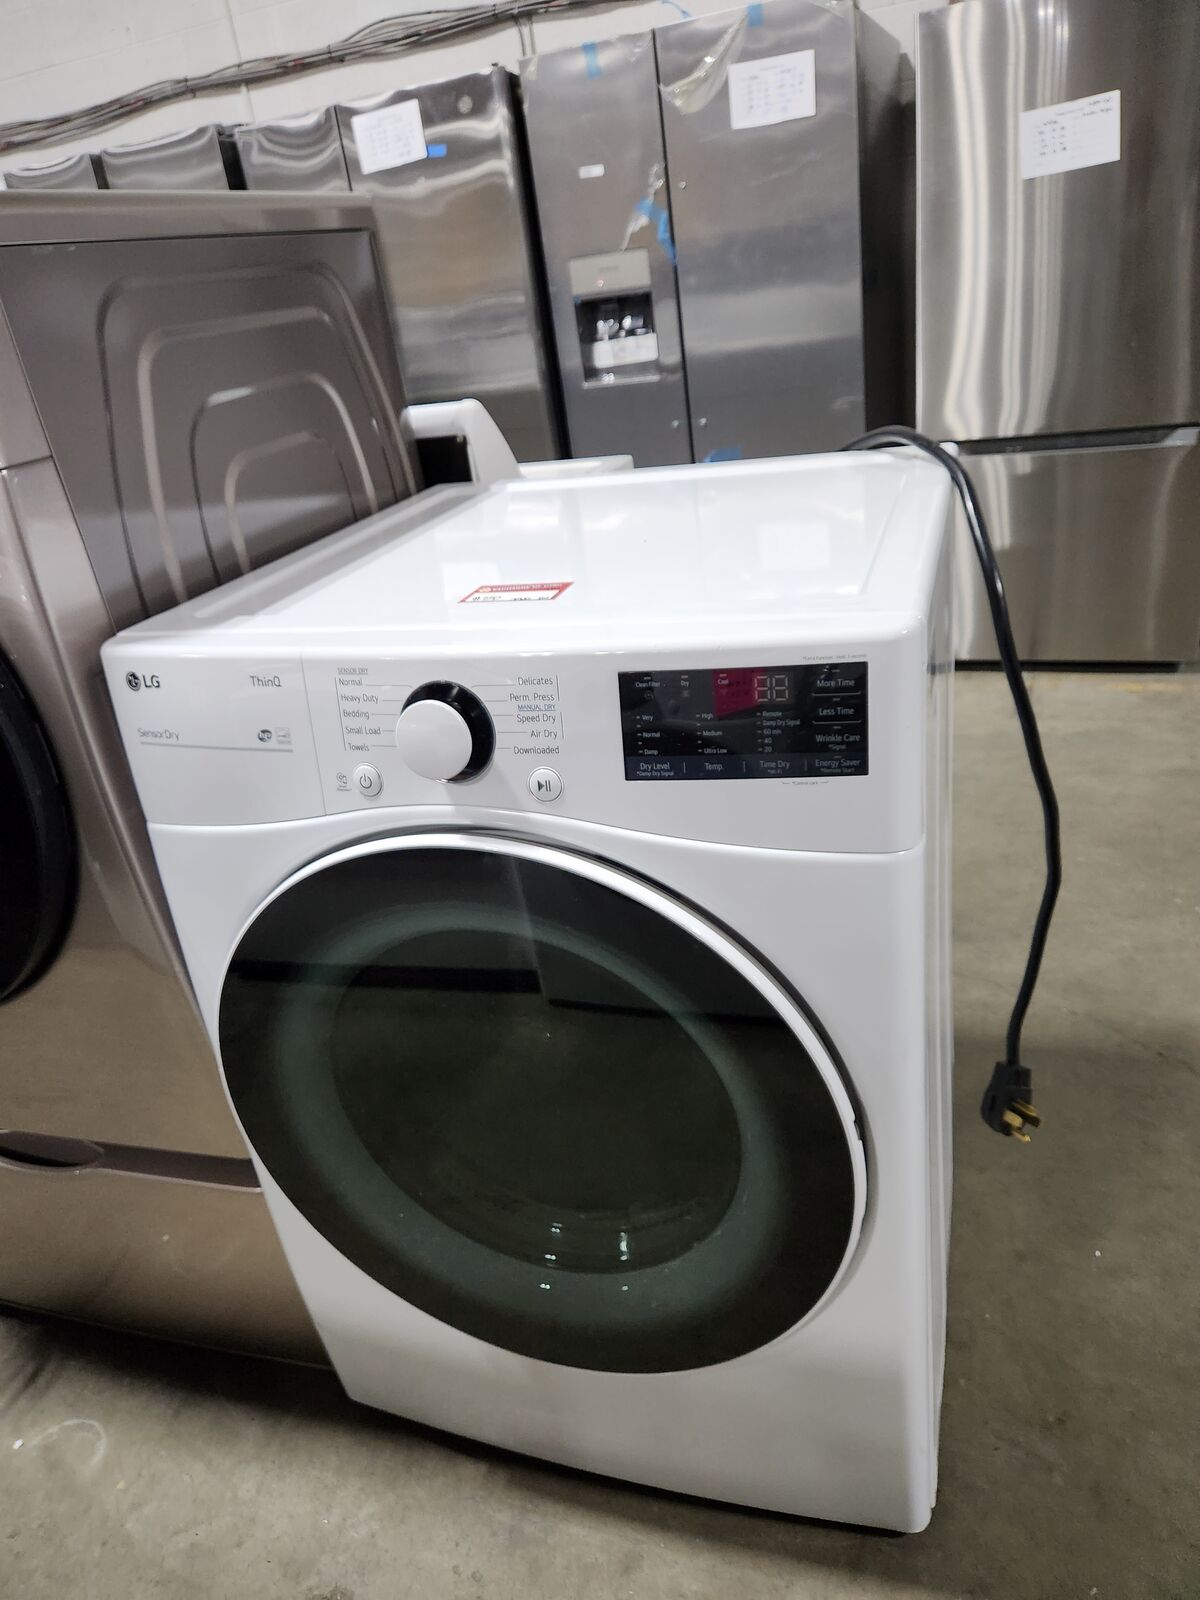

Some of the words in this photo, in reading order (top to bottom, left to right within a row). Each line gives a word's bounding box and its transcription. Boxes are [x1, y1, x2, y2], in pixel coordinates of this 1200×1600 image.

[142, 674, 160, 688] LG
[249, 675, 283, 688] ThinQ
[338, 678, 362, 686] Normal
[518, 676, 554, 686] Delicates
[816, 680, 836, 688] More
[837, 678, 855, 686] Time
[340, 694, 361, 703] Heavy
[362, 694, 379, 703] Duty
[510, 693, 530, 702] Perm.
[533, 692, 555, 702] Press
[344, 710, 370, 720] Bedding
[819, 708, 835, 716] Less
[836, 707, 854, 715] Time
[516, 714, 540, 724] Speed
[542, 714, 556, 724] Dry
[346, 726, 363, 734] Small
[365, 727, 381, 735] Load
[530, 730, 542, 738] Air
[544, 730, 558, 740] Dry
[816, 734, 842, 742] Wrinkle
[844, 734, 860, 742] Care
[348, 743, 370, 752] Towels
[514, 746, 560, 755] Downloaded
[640, 762, 652, 770] Dry
[653, 762, 670, 770] Level
[706, 762, 724, 771] Temp.
[778, 760, 790, 769] Dry
[816, 760, 839, 768] Energy
[840, 759, 860, 767] Saver
